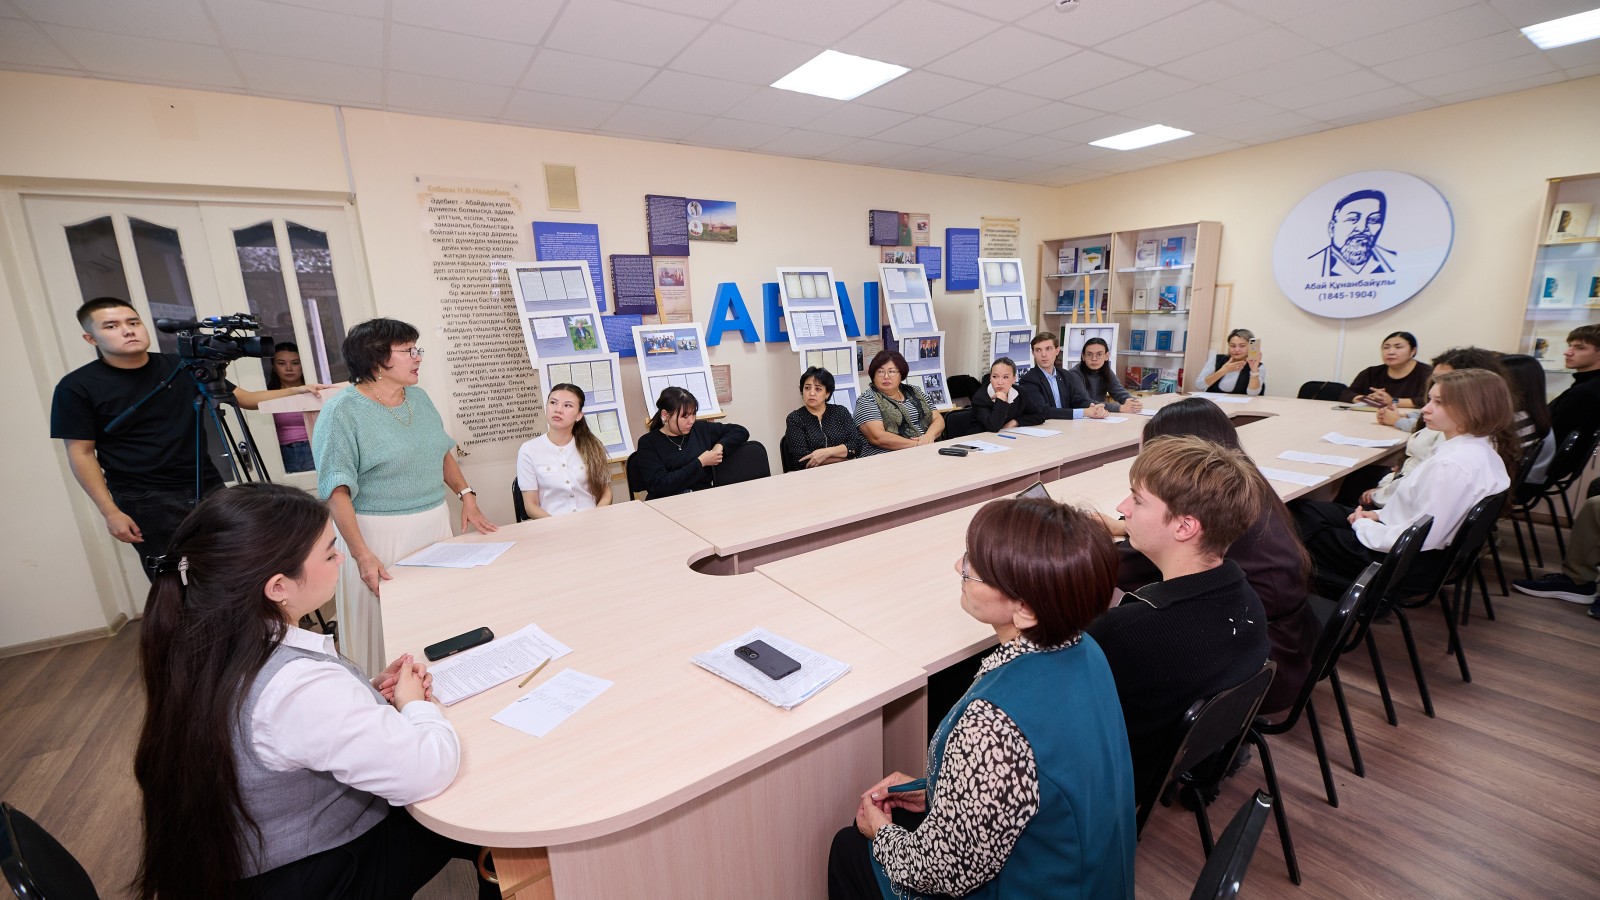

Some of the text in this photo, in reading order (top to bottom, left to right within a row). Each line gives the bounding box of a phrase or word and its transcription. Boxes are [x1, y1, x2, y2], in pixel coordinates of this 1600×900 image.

[430, 198, 458, 206] Әдебиет
[465, 199, 494, 208] Абайдың
[428, 206, 457, 214] дүниелік
[434, 222, 514, 231] заманалық болмыстарға
[430, 228, 466, 236] бойлайтын
[441, 244, 459, 252] дейін
[450, 282, 460, 290] бір
[1304, 282, 1327, 291] Абай
[449, 289, 459, 297] бір
[1318, 291, 1377, 301] (1845-1904)
[479, 296, 499, 304] бастау
[441, 312, 470, 320] ұмтылар
[469, 318, 505, 326] баспалдағы
[443, 326, 472, 334] Абайдың
